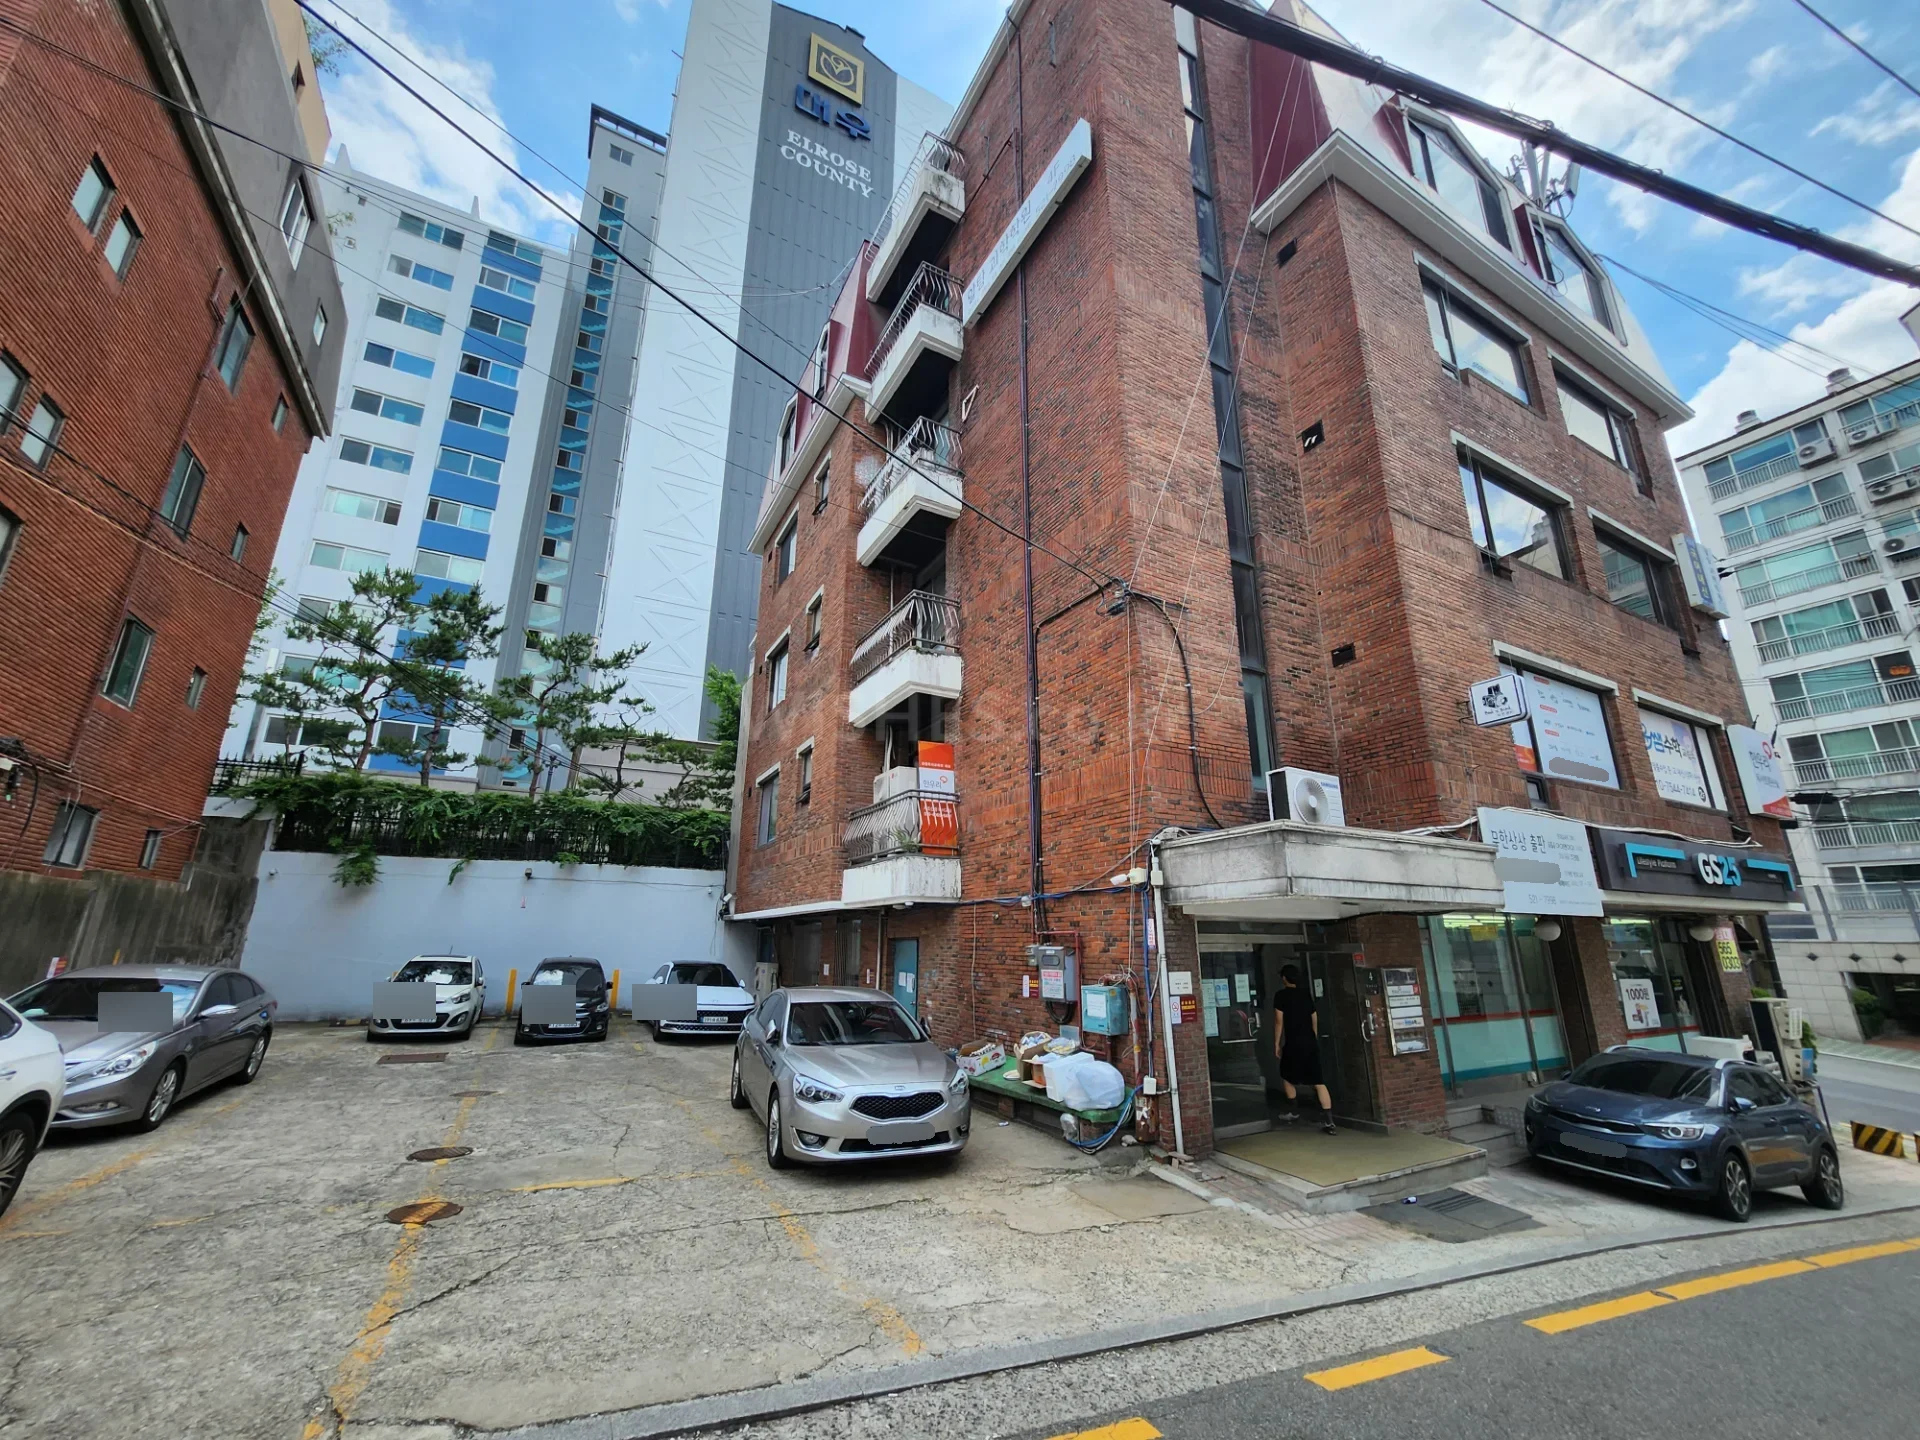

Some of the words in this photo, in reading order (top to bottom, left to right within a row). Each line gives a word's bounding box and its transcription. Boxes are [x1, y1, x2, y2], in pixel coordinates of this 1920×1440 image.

[795, 84, 871, 141] 대우
[780, 145, 873, 198] COUNTY
[786, 129, 872, 182] ELROSE
[1491, 829, 1527, 852] 무한상상
[1530, 833, 1547, 855] 출판
[1697, 852, 1741, 887] GS25
